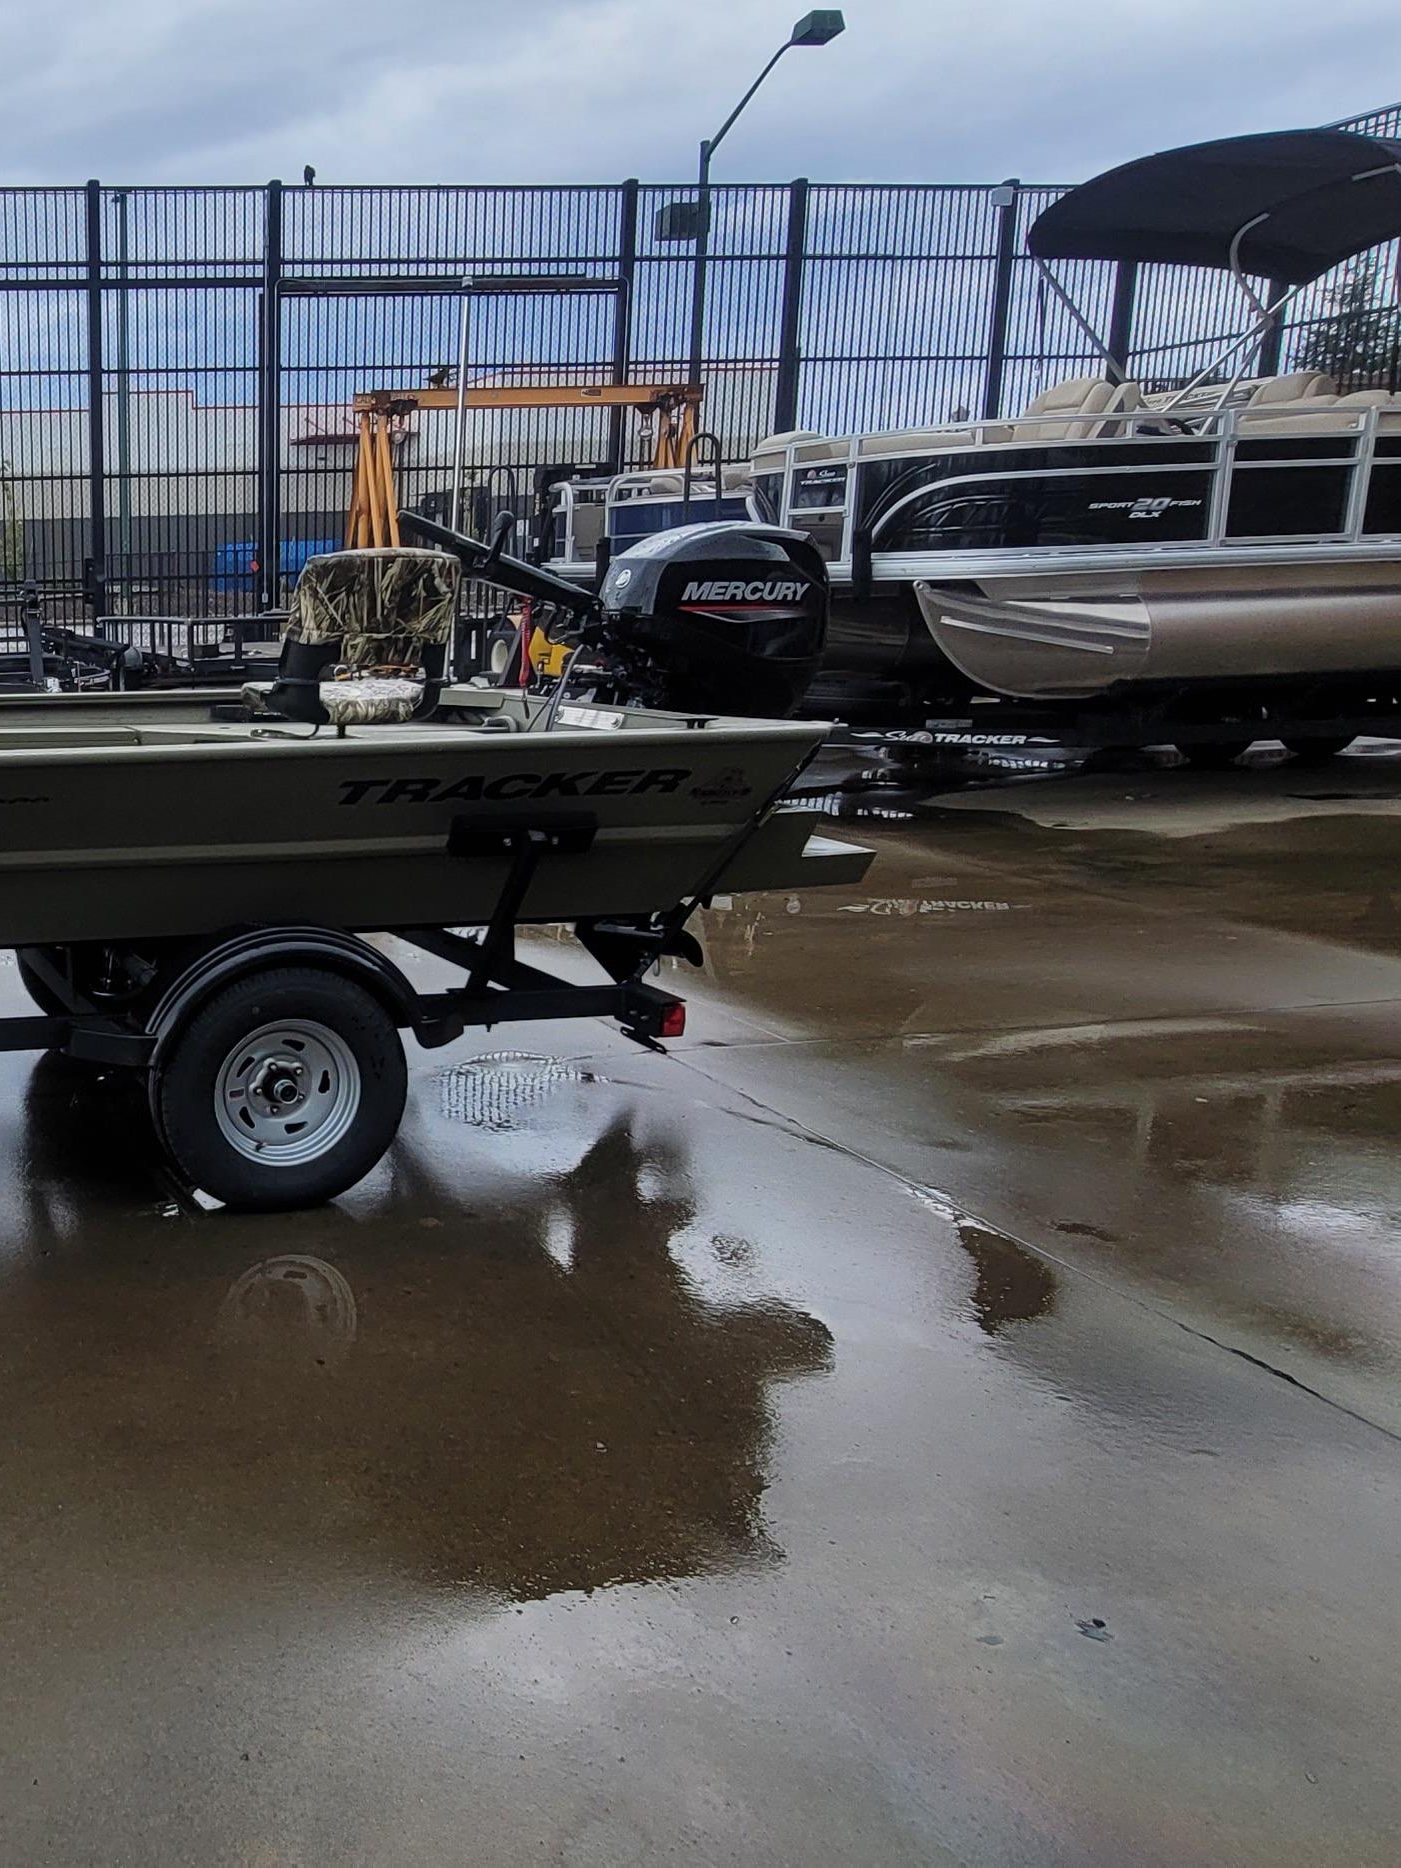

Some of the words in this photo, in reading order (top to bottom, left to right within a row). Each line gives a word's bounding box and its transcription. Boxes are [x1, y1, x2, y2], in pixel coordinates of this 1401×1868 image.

[1088, 501, 1135, 510] SPORT
[1131, 497, 1173, 511] 20
[1169, 499, 1202, 507] FISH
[681, 581, 812, 601] MERCURY
[934, 732, 1028, 745] TRACKER
[338, 768, 693, 806] TRACKER
